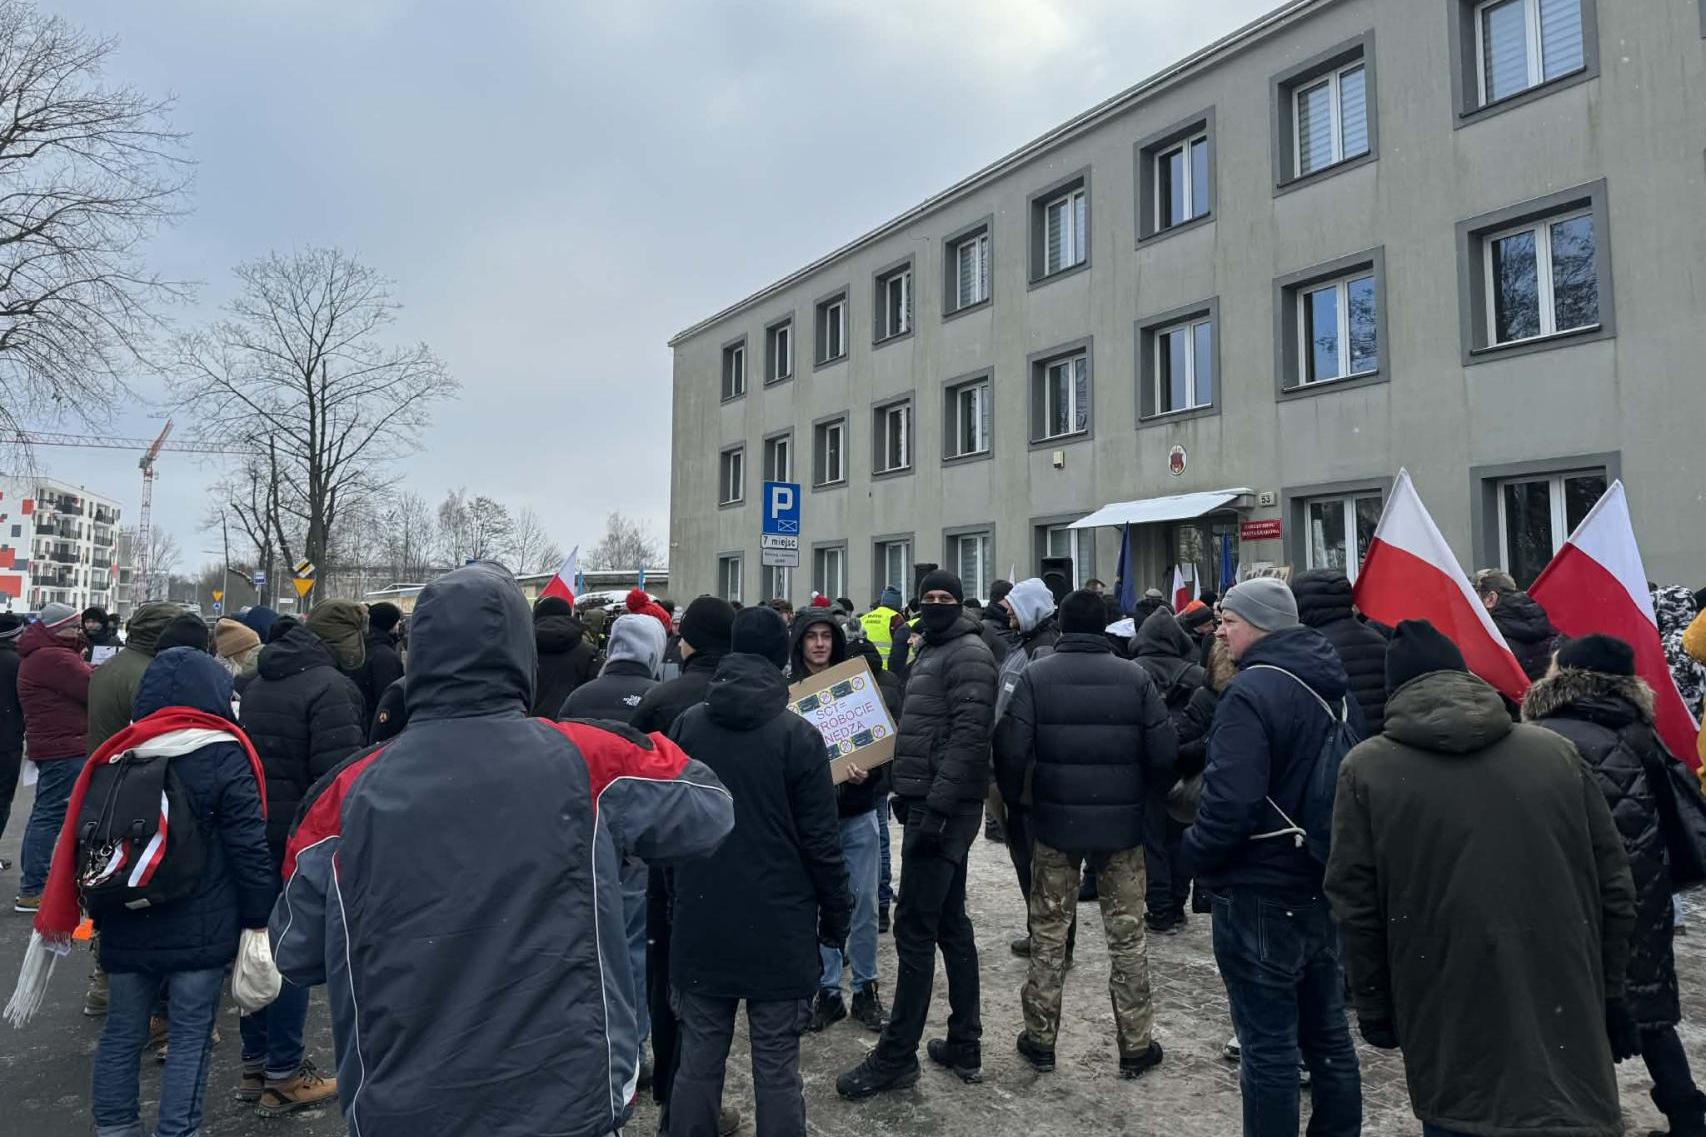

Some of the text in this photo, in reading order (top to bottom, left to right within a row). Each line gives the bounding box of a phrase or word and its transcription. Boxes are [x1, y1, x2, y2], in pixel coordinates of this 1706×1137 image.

[771, 486, 793, 519] P
[1260, 494, 1271, 504] 53
[763, 536, 795, 548] 7 miejsc
